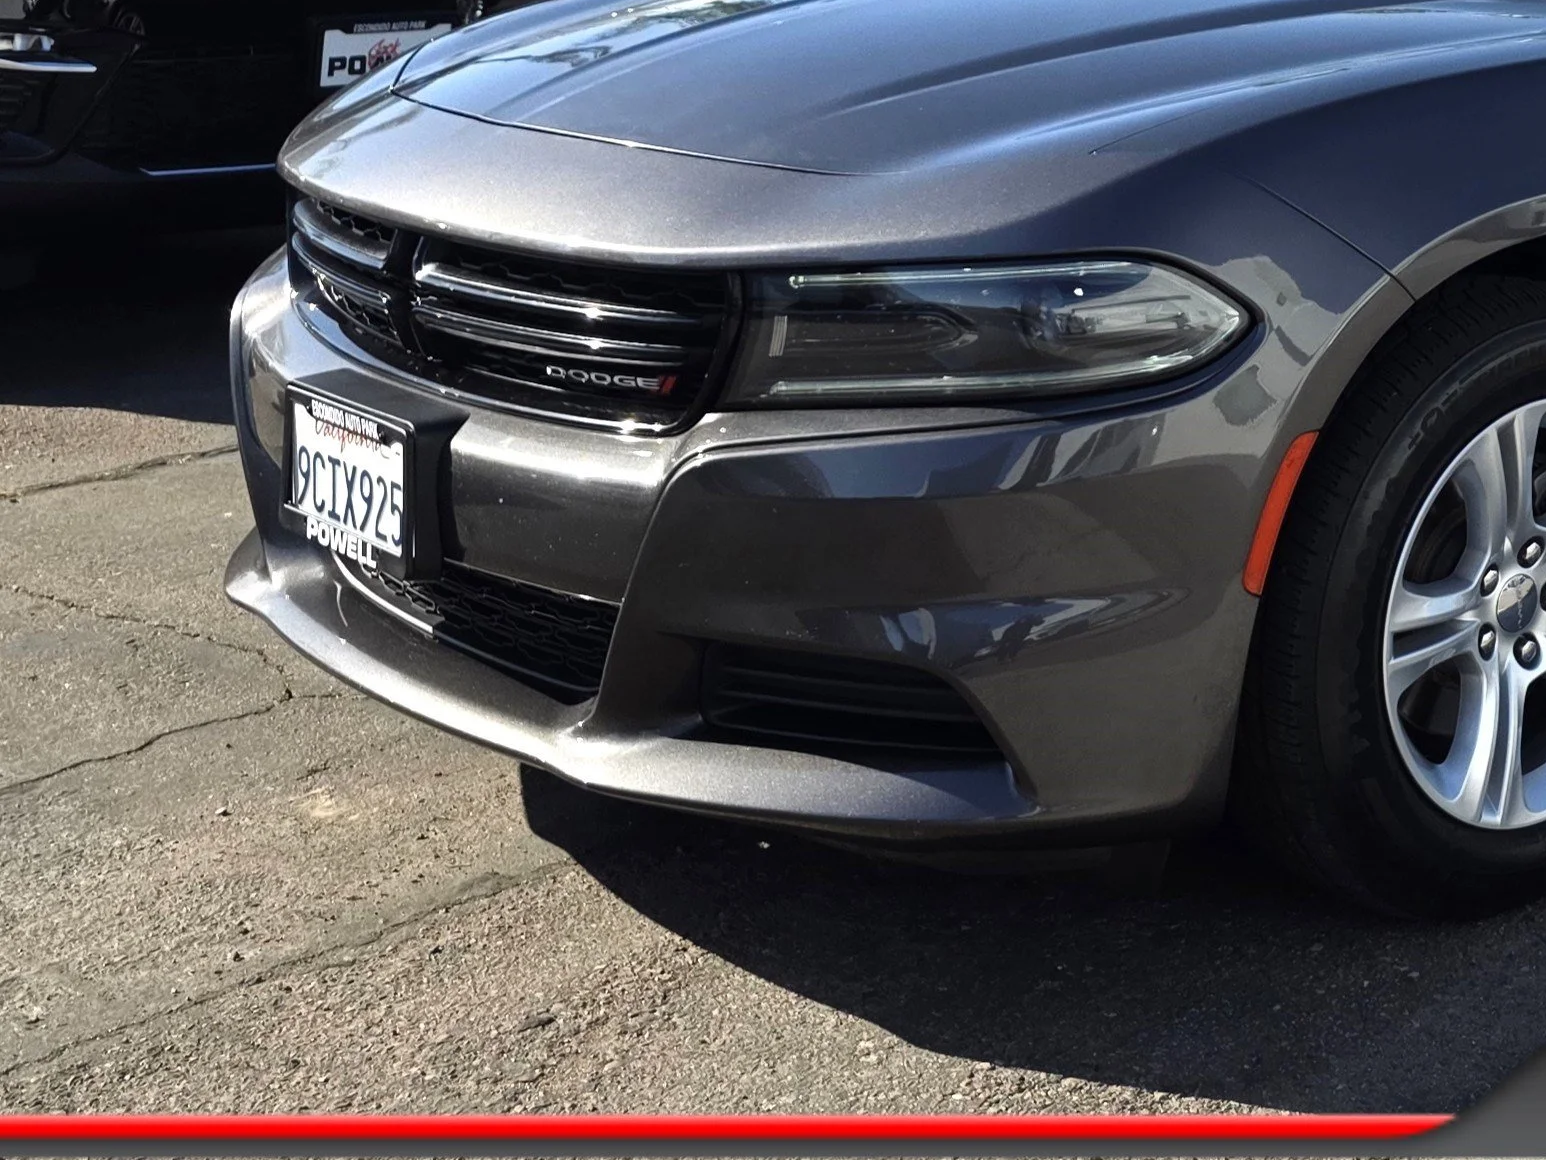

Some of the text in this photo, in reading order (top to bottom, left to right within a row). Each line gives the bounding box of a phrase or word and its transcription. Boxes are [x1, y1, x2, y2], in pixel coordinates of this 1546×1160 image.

[546, 365, 660, 390] DODGE
[298, 445, 402, 546] 9CIX925
[307, 515, 378, 568] POWELL
